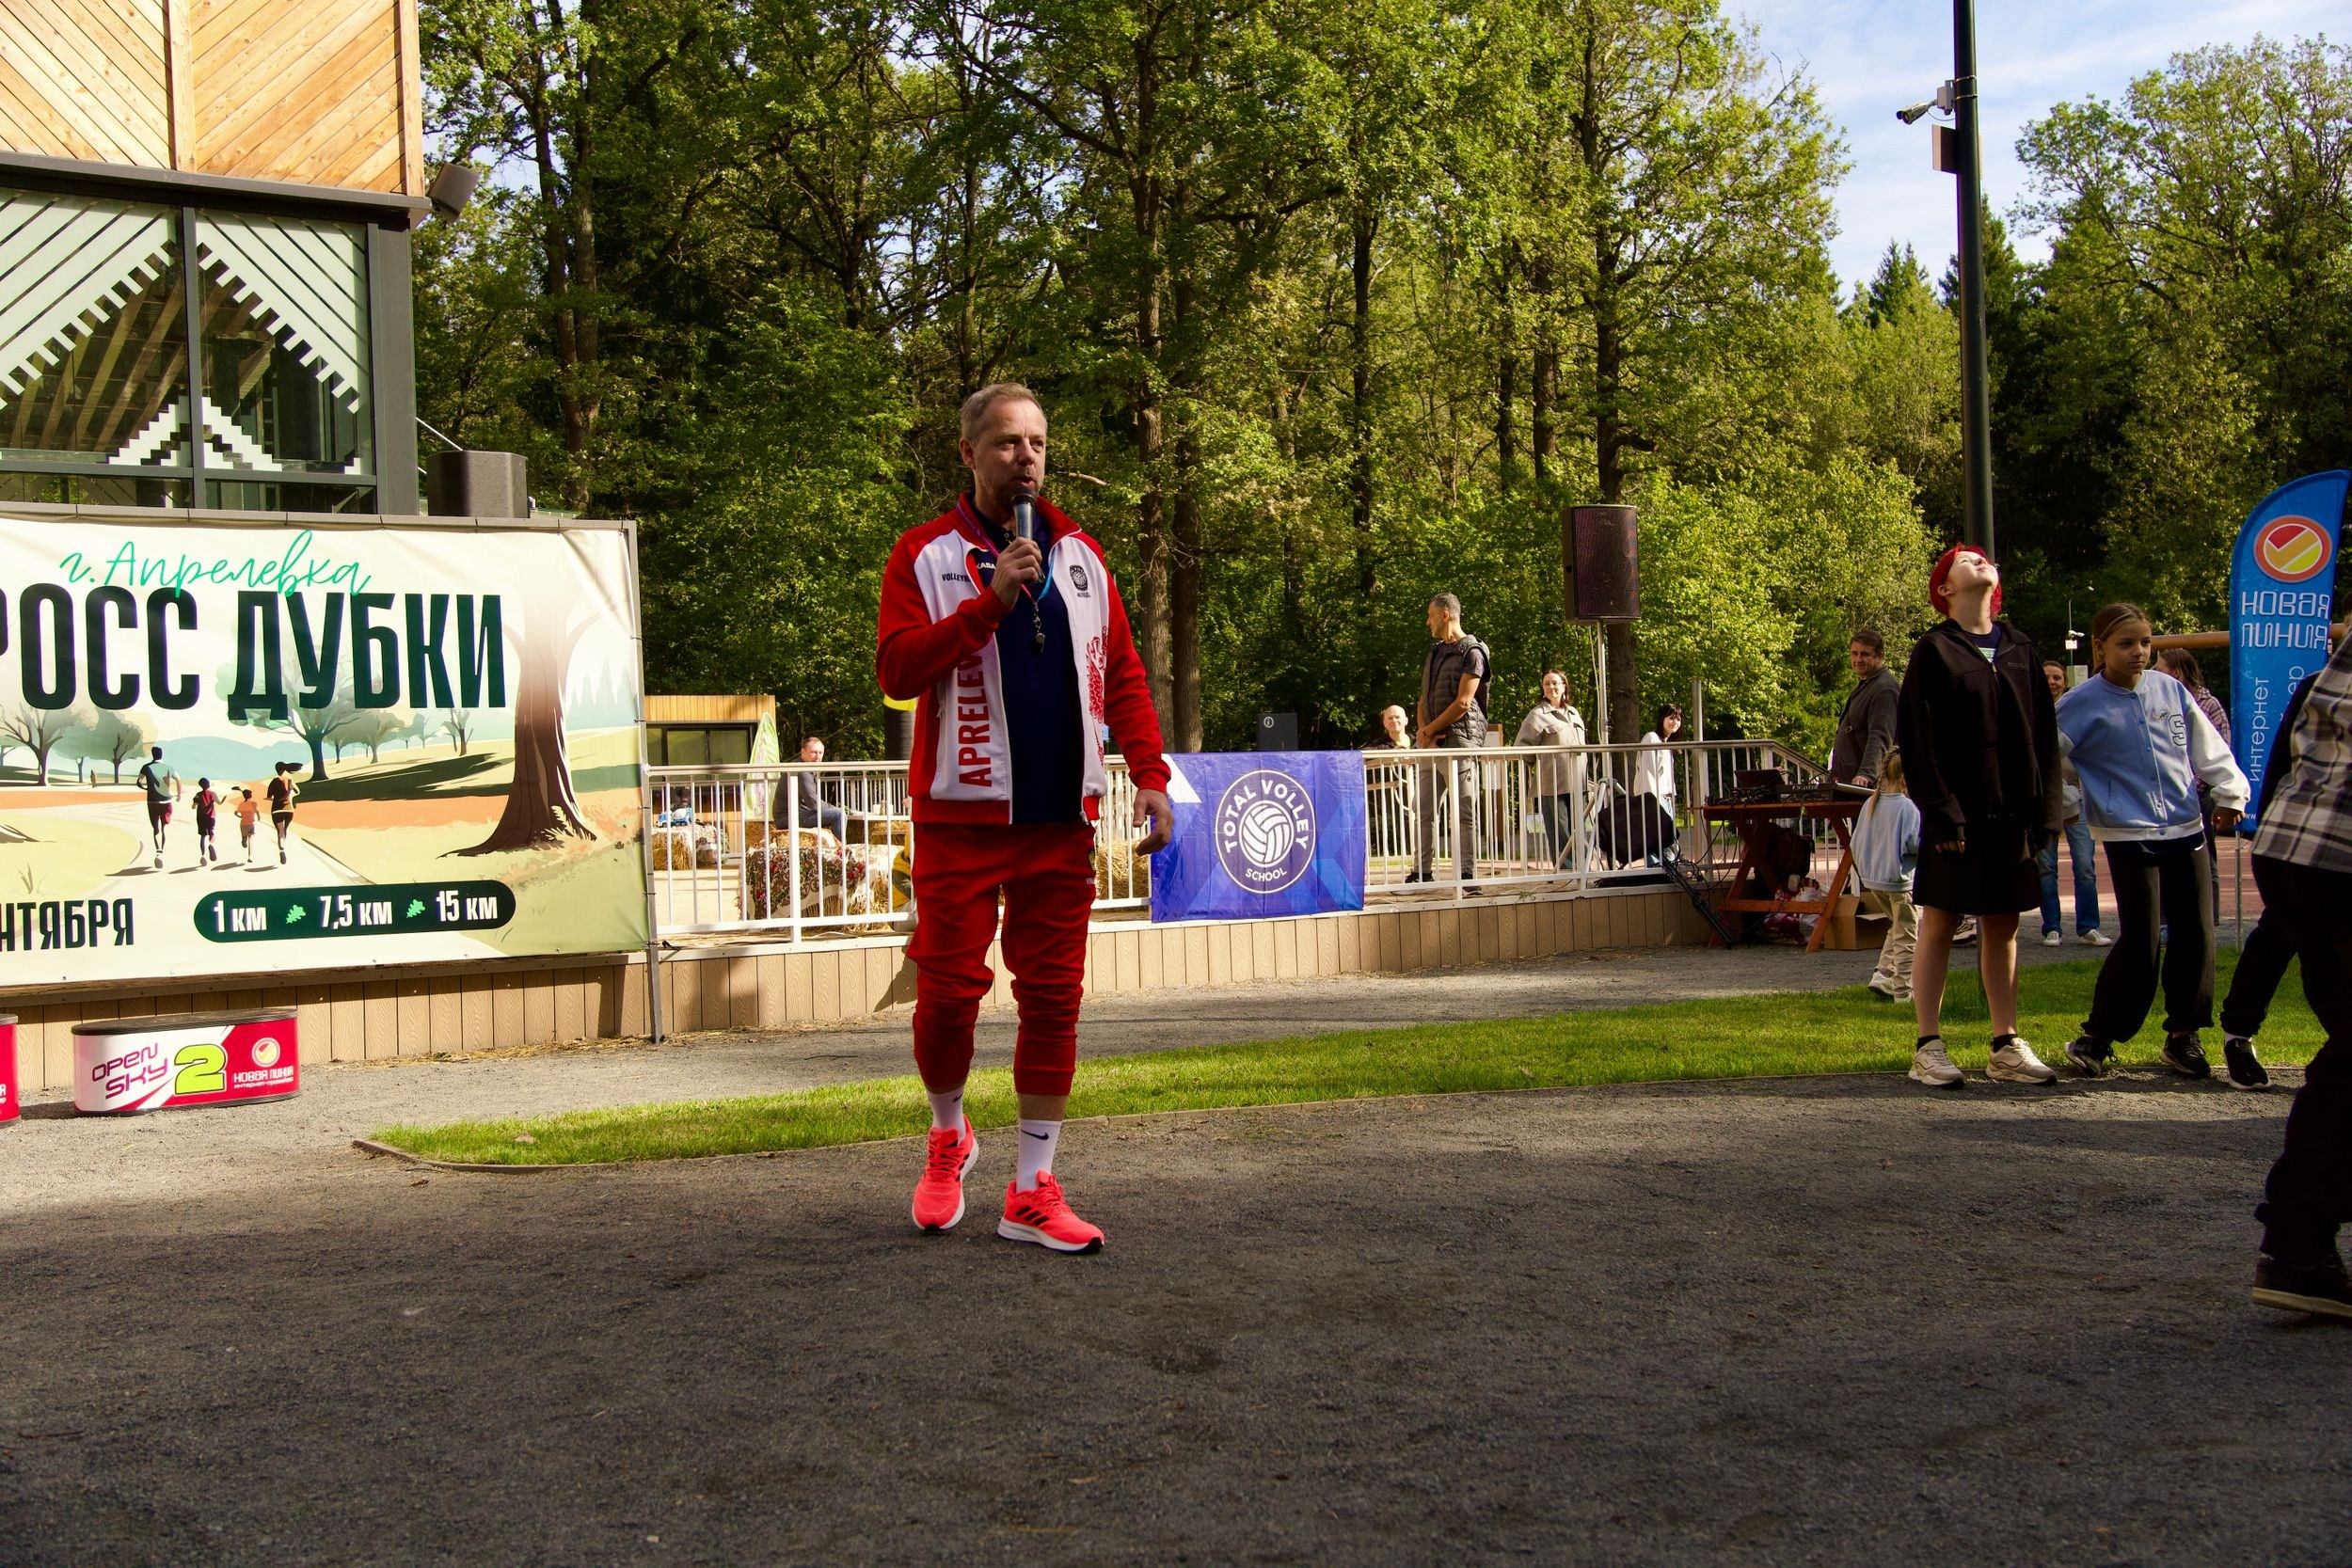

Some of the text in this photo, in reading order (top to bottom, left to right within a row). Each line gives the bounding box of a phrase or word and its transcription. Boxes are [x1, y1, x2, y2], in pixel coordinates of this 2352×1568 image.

[103, 529, 372, 597] Апрелевка
[942, 573, 971, 582] VOLLEYB
[0, 582, 507, 721] ОСС ДУБКИ
[2168, 713, 2186, 747] S
[1223, 779, 1310, 853] TOTAL VOLLEY
[1245, 866, 1288, 882] SCHOOL
[213, 899, 225, 932] 1
[318, 895, 354, 929] 7,5
[436, 890, 460, 922] 15
[174, 1043, 227, 1095] 2
